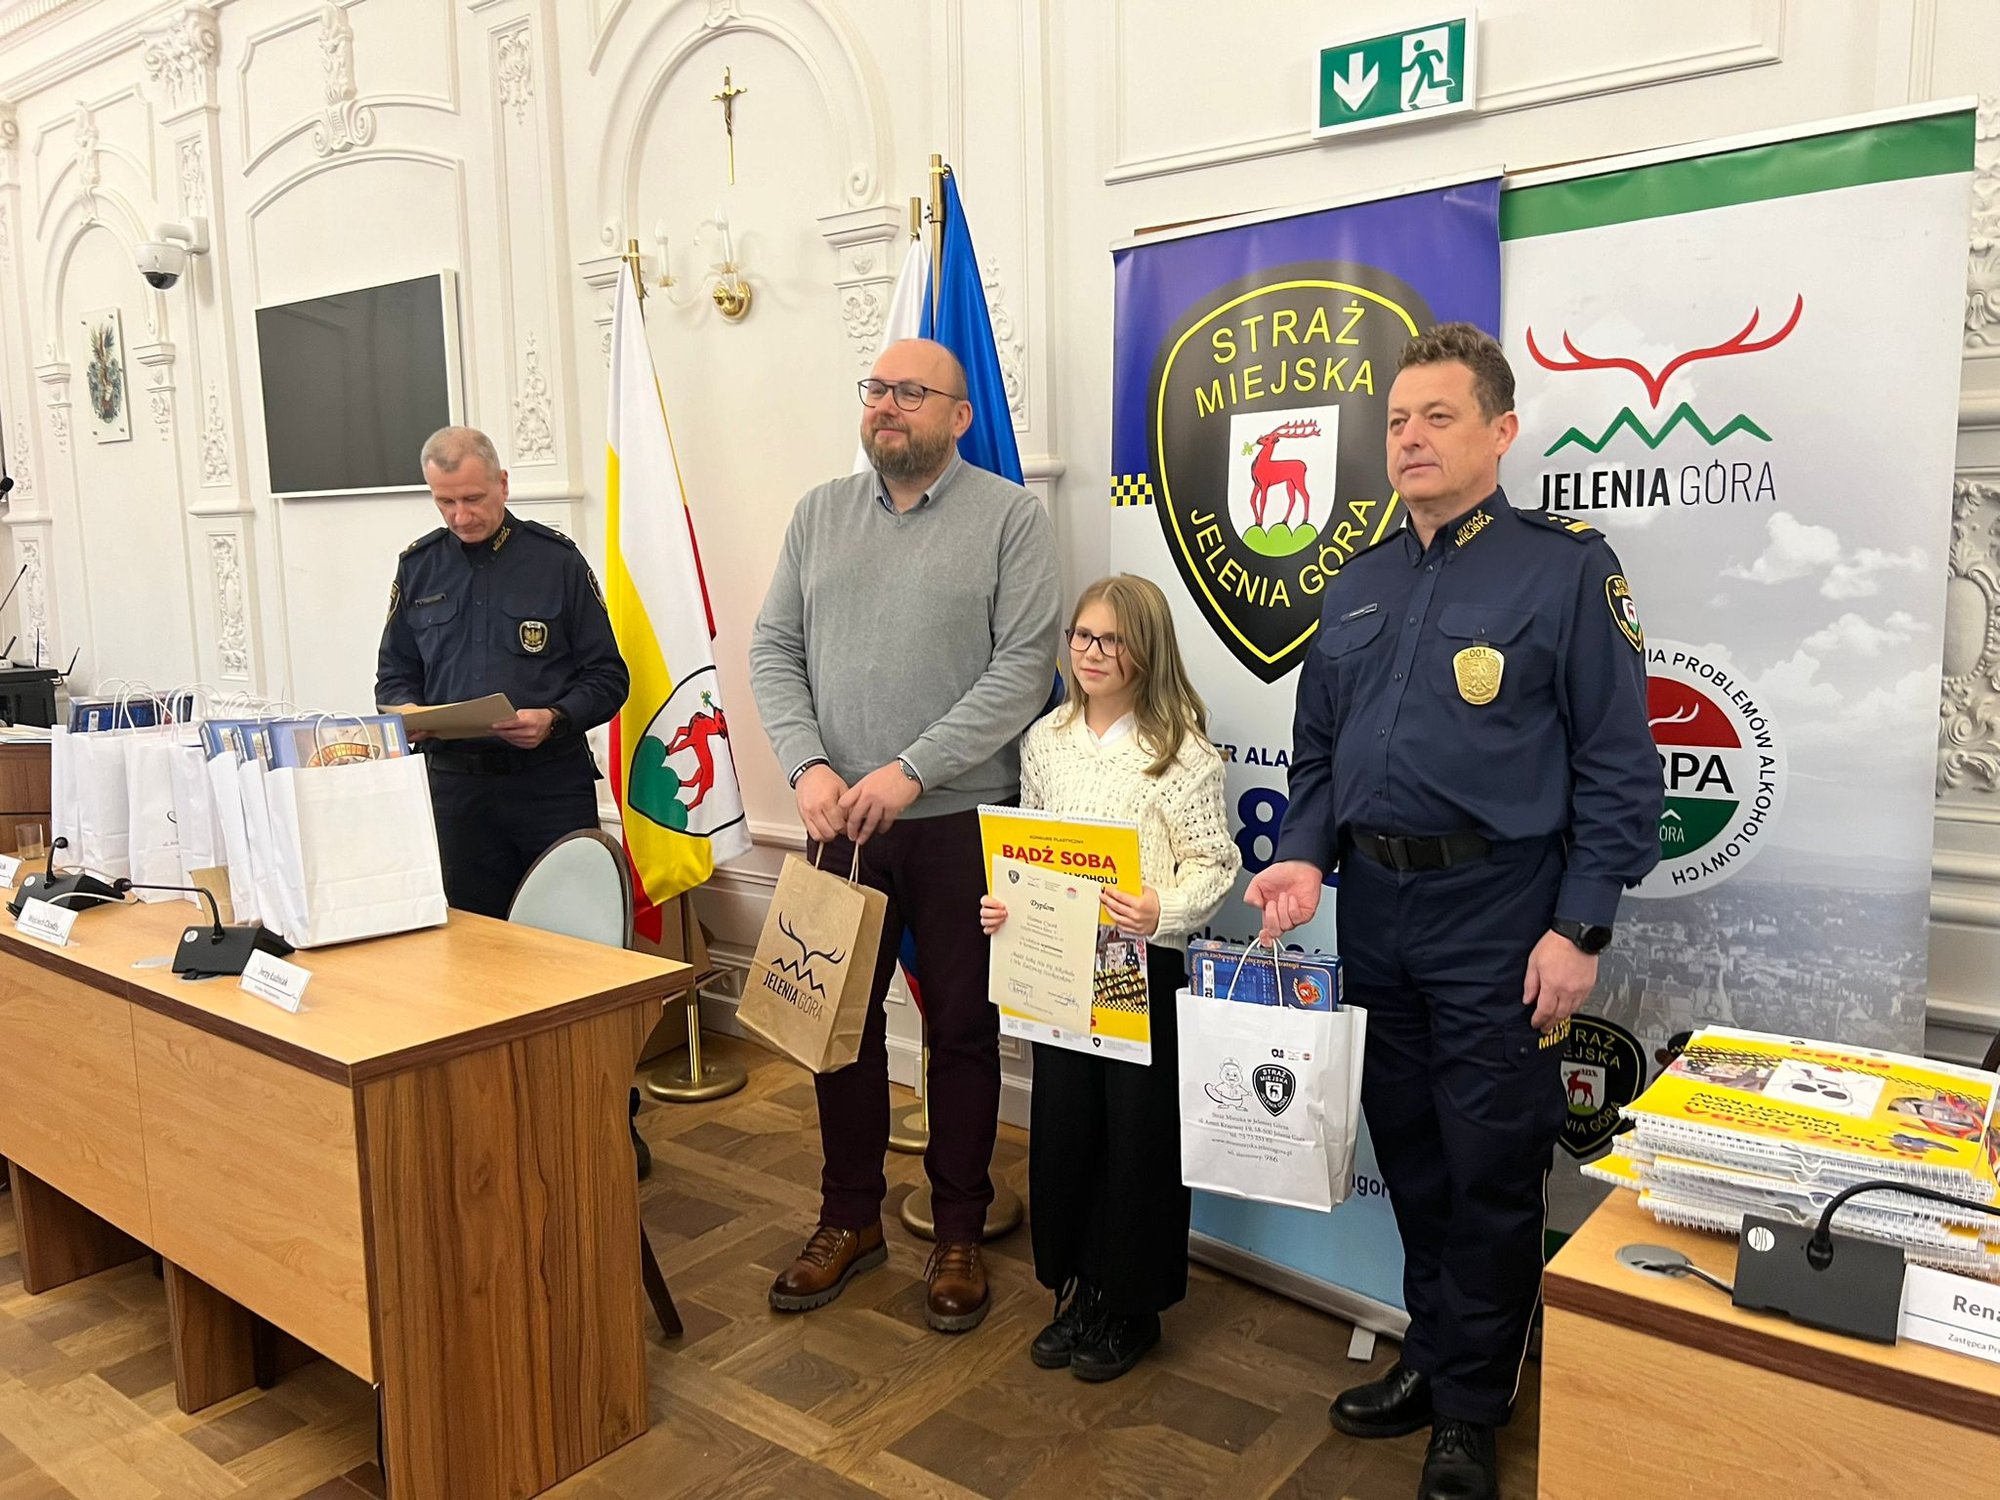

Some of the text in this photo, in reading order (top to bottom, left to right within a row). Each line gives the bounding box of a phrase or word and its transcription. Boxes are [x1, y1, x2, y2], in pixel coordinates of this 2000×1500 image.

[1211, 299, 1366, 364] STRAŻ
[1194, 357, 1375, 418] MIEJSKA
[1540, 459, 1776, 511] JELENIA GÓRA
[1190, 498, 1377, 608] JELENIA GÓRA
[1469, 649, 1487, 658] 001
[1672, 652, 1773, 748] PROBLEMÓW
[1671, 755, 1776, 886] ALKOHOLOWYCH
[1002, 844, 1117, 874] BĄDŹ SOBĄ
[1030, 899, 1055, 912] Dyplom
[763, 971, 798, 1005] JELENIA
[1948, 1333, 1987, 1351] Zastępca
